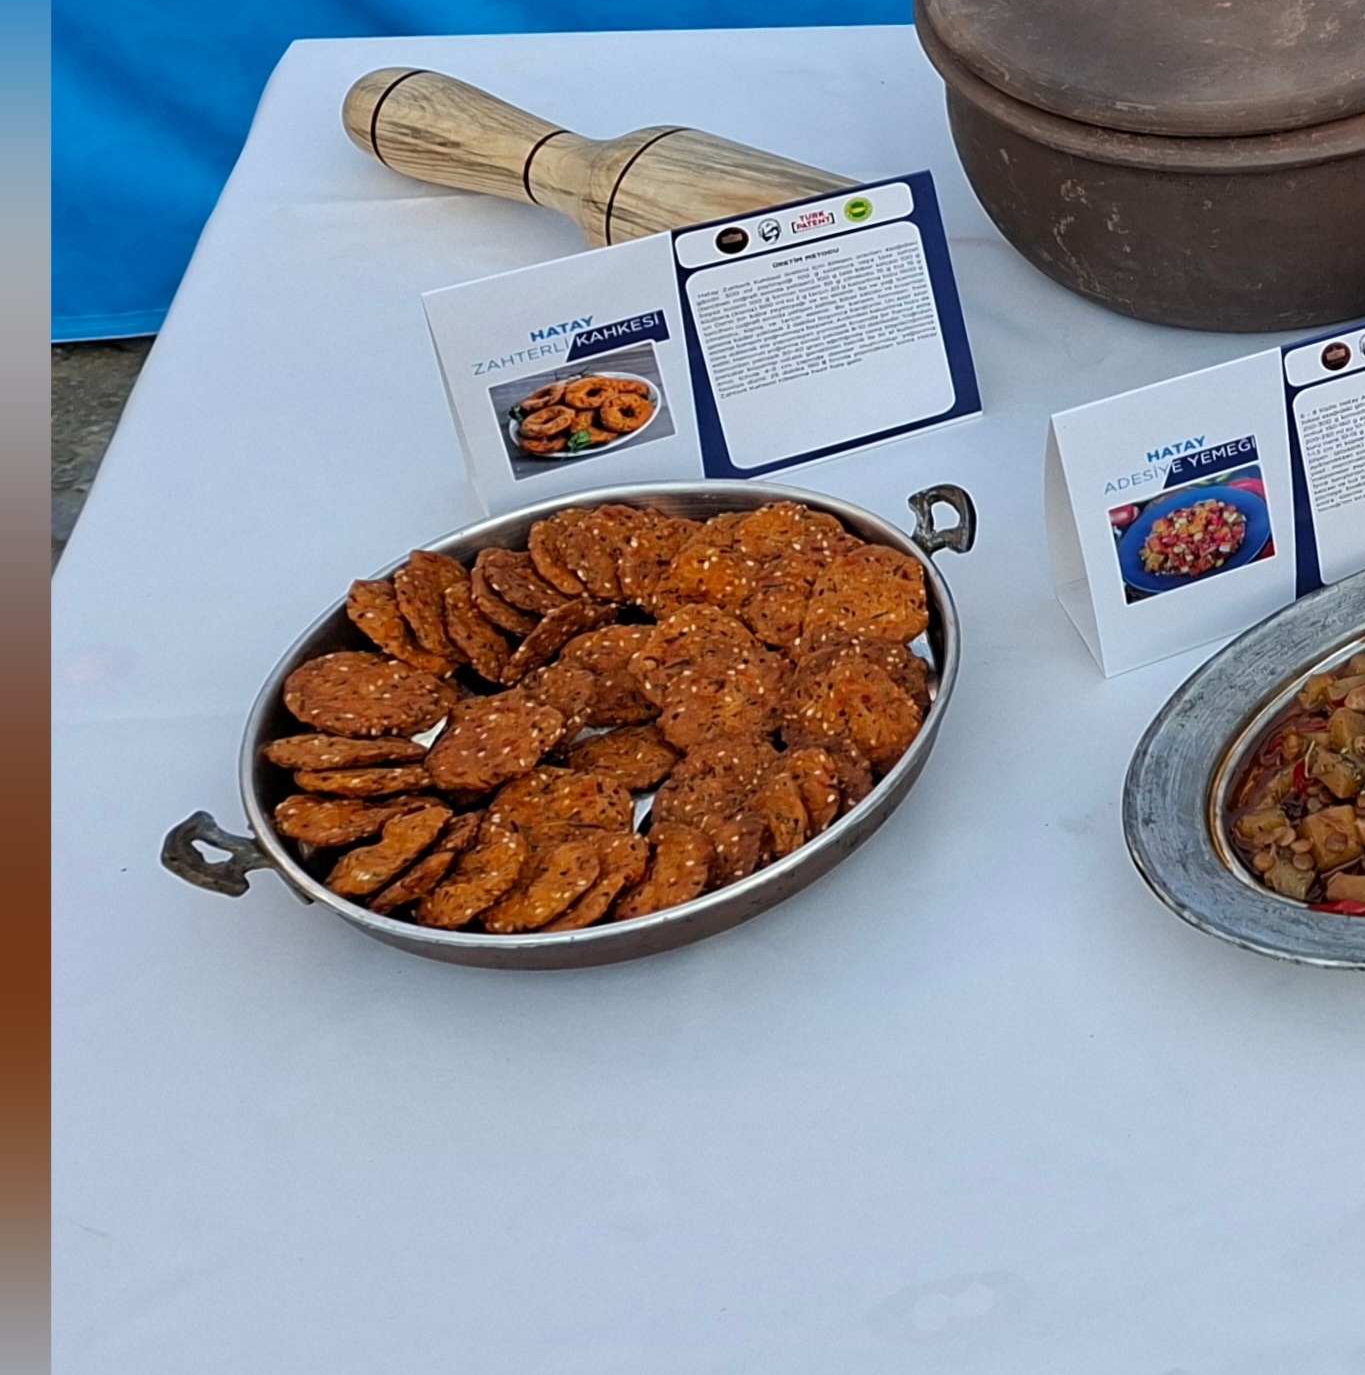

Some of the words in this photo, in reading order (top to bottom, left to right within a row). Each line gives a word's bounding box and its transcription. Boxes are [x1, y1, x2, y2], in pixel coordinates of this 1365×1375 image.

[471, 337, 570, 376] ZAHTERLİ
[575, 312, 660, 347] KAHKESİ
[530, 316, 593, 342] HATAY
[1147, 436, 1205, 463] HATAY
[1104, 460, 1182, 495] ADESİYE
